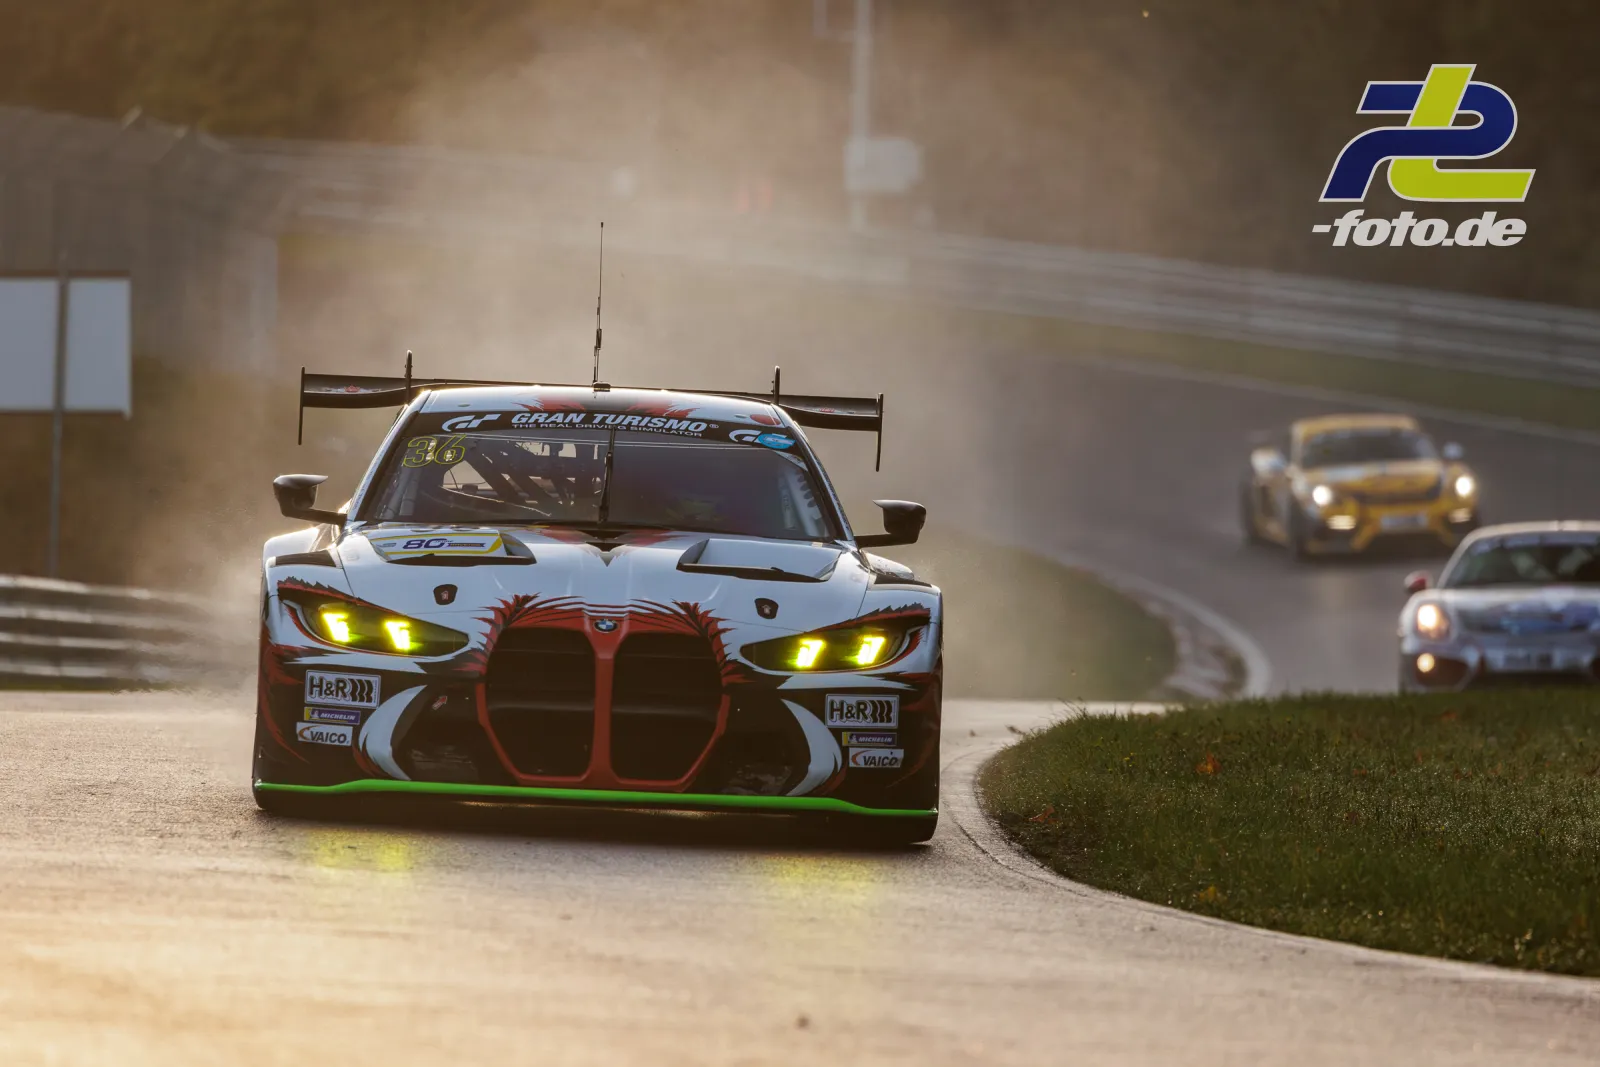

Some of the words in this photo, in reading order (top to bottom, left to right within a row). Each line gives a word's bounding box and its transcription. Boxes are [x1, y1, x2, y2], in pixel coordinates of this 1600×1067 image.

[511, 412, 587, 424] GRAN
[630, 426, 702, 437] SIMULATOR
[403, 434, 467, 468] 36
[403, 538, 447, 549] 80
[308, 675, 349, 699] H&R
[320, 712, 356, 721] MICHELIN
[829, 699, 870, 722] H&R
[309, 731, 347, 744] VAICO
[862, 755, 899, 767] VAICO
